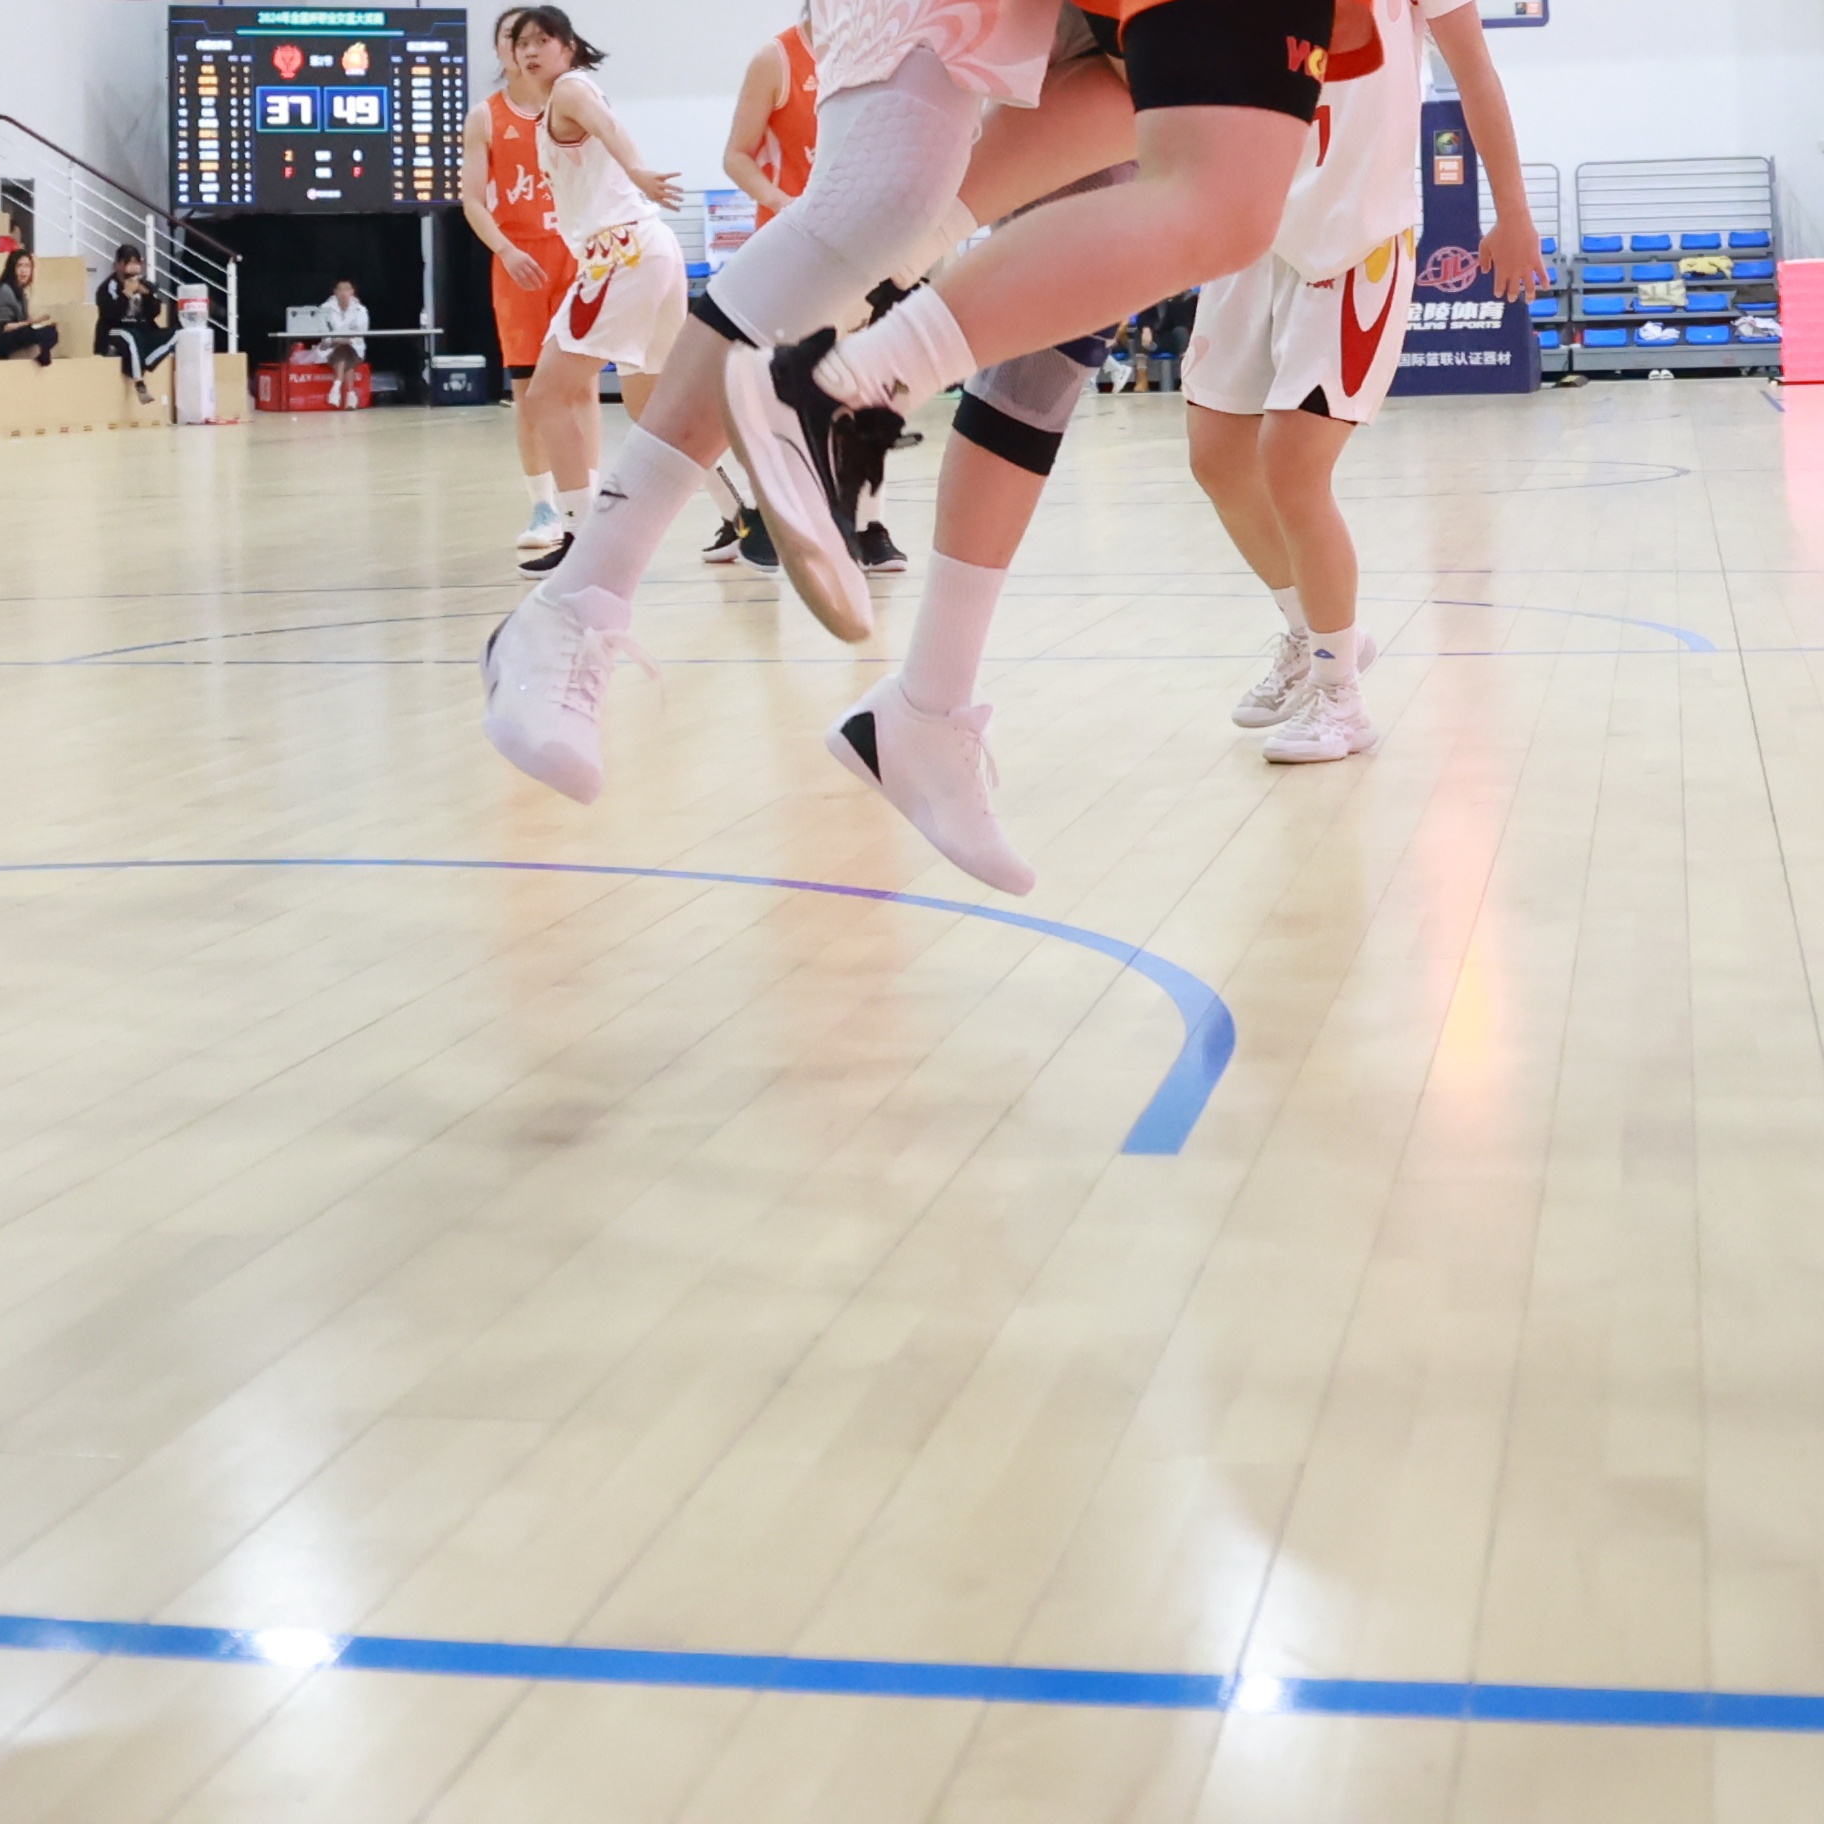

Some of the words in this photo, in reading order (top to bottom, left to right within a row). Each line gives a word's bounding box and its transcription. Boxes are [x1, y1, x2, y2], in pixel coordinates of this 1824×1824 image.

[266, 95, 312, 125] 37
[332, 95, 380, 125] 49
[1450, 320, 1503, 330] SPORTS
[1398, 350, 1512, 367] 国际篮联认证器材
